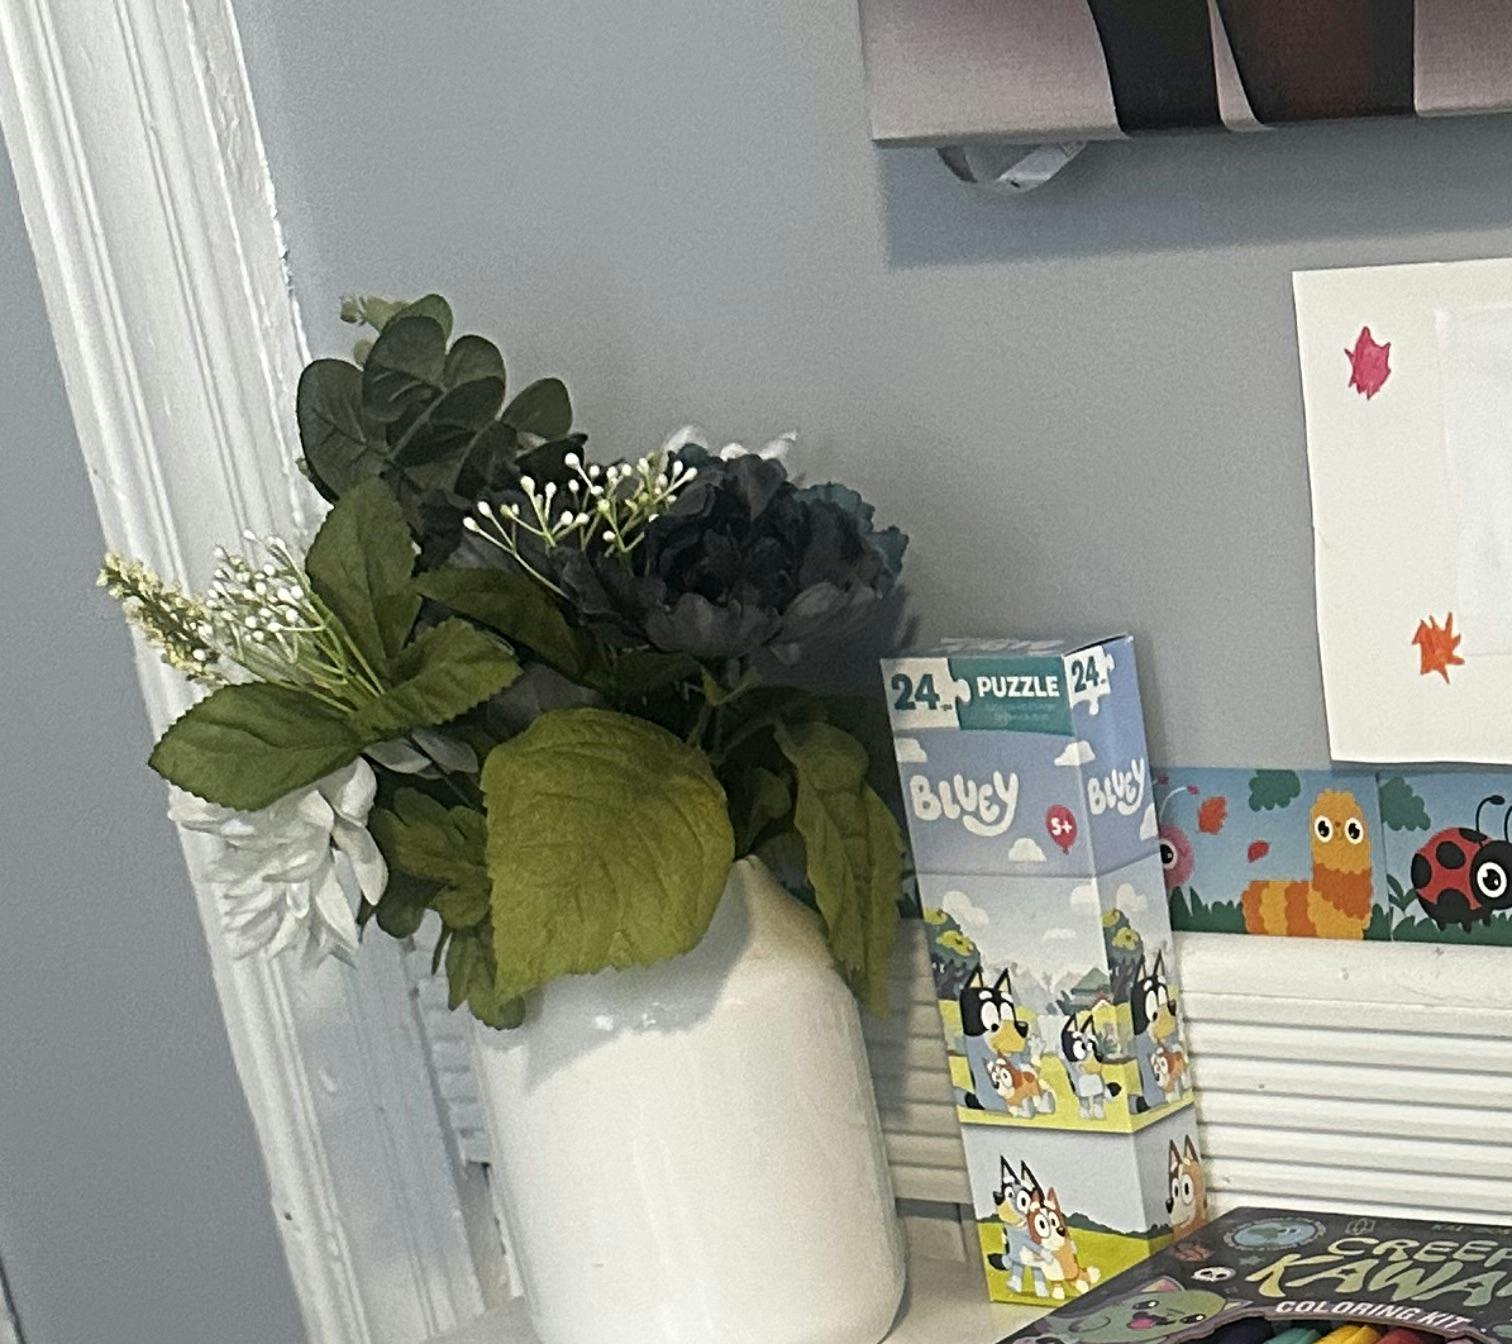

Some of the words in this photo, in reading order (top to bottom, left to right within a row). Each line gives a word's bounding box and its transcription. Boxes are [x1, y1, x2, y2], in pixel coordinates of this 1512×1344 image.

[891, 673, 939, 711] 24
[976, 675, 1060, 698] PUZZLE
[1071, 656, 1101, 693] 24
[1275, 1301, 1424, 1323] COLORING
[1420, 1311, 1474, 1330] KIT
